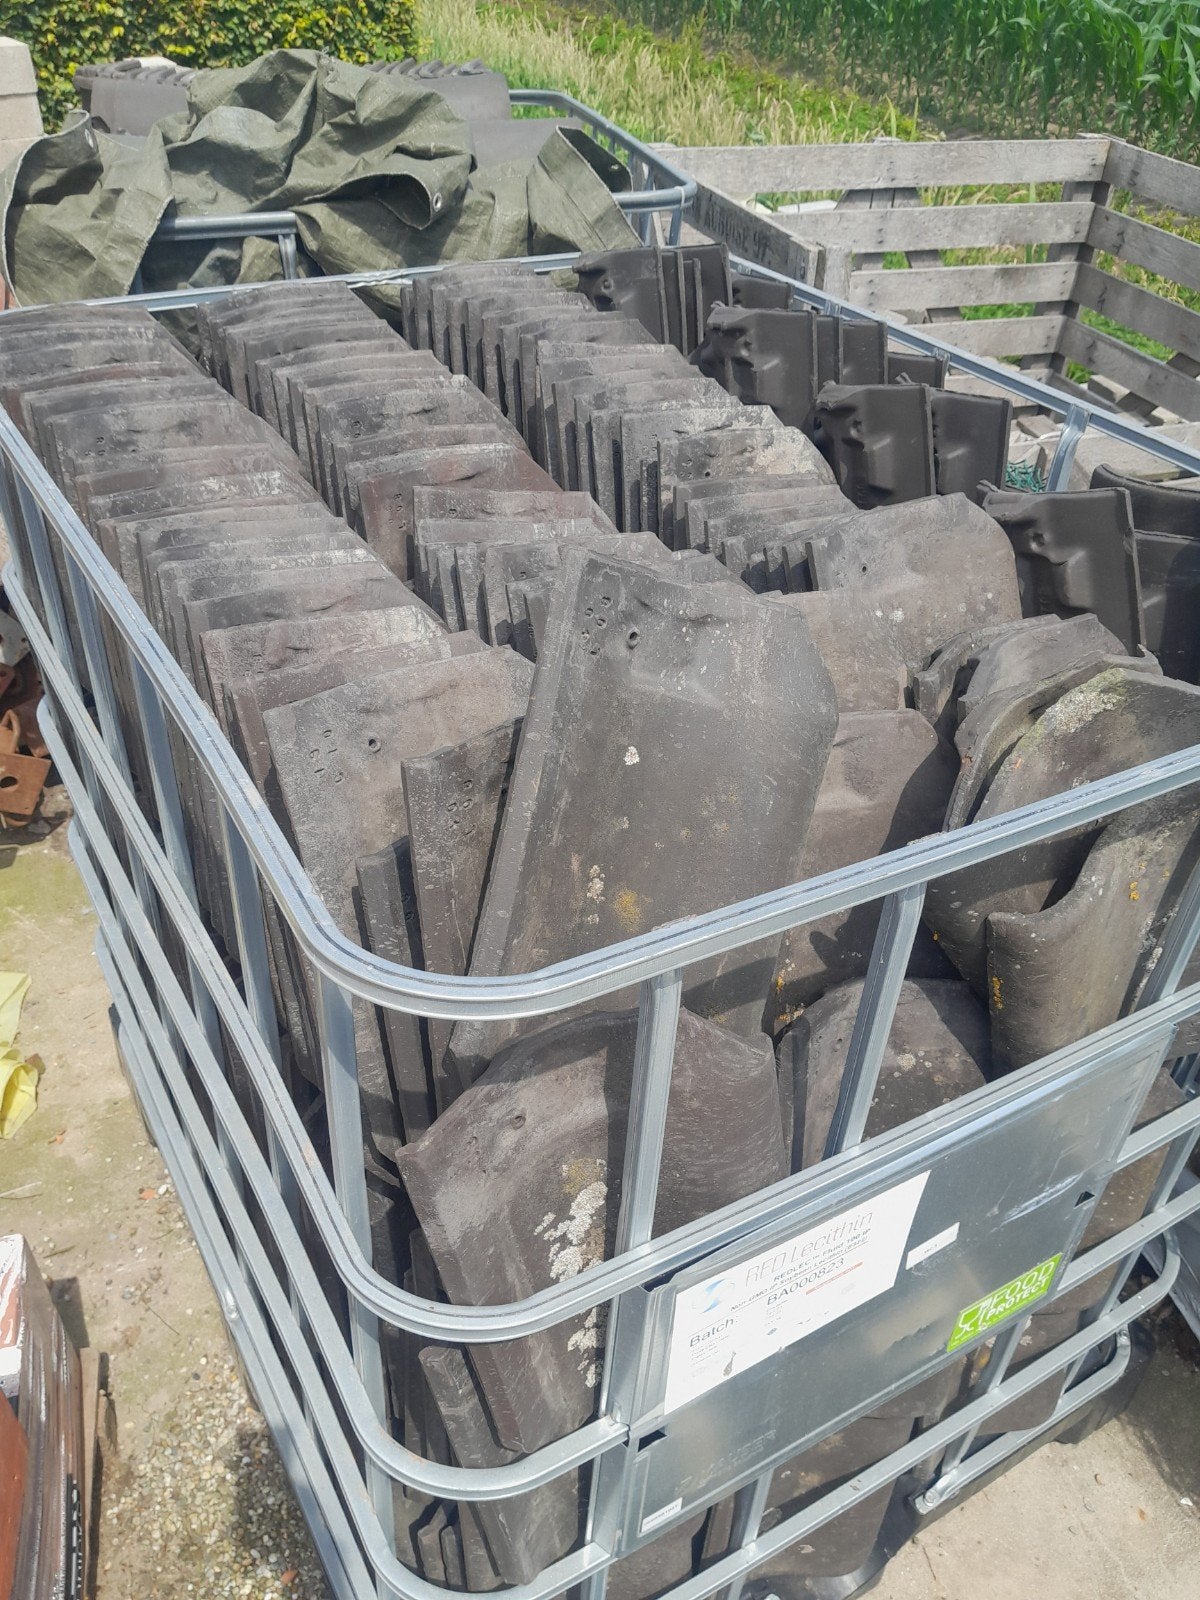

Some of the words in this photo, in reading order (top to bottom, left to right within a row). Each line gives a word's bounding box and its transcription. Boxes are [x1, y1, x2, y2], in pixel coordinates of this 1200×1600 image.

[746, 1252, 787, 1287] RED
[790, 1212, 873, 1263] Lecithin
[767, 1257, 845, 1305] BA000823
[985, 1275, 1050, 1320] PROTECT
[989, 1261, 1055, 1309] FOOD
